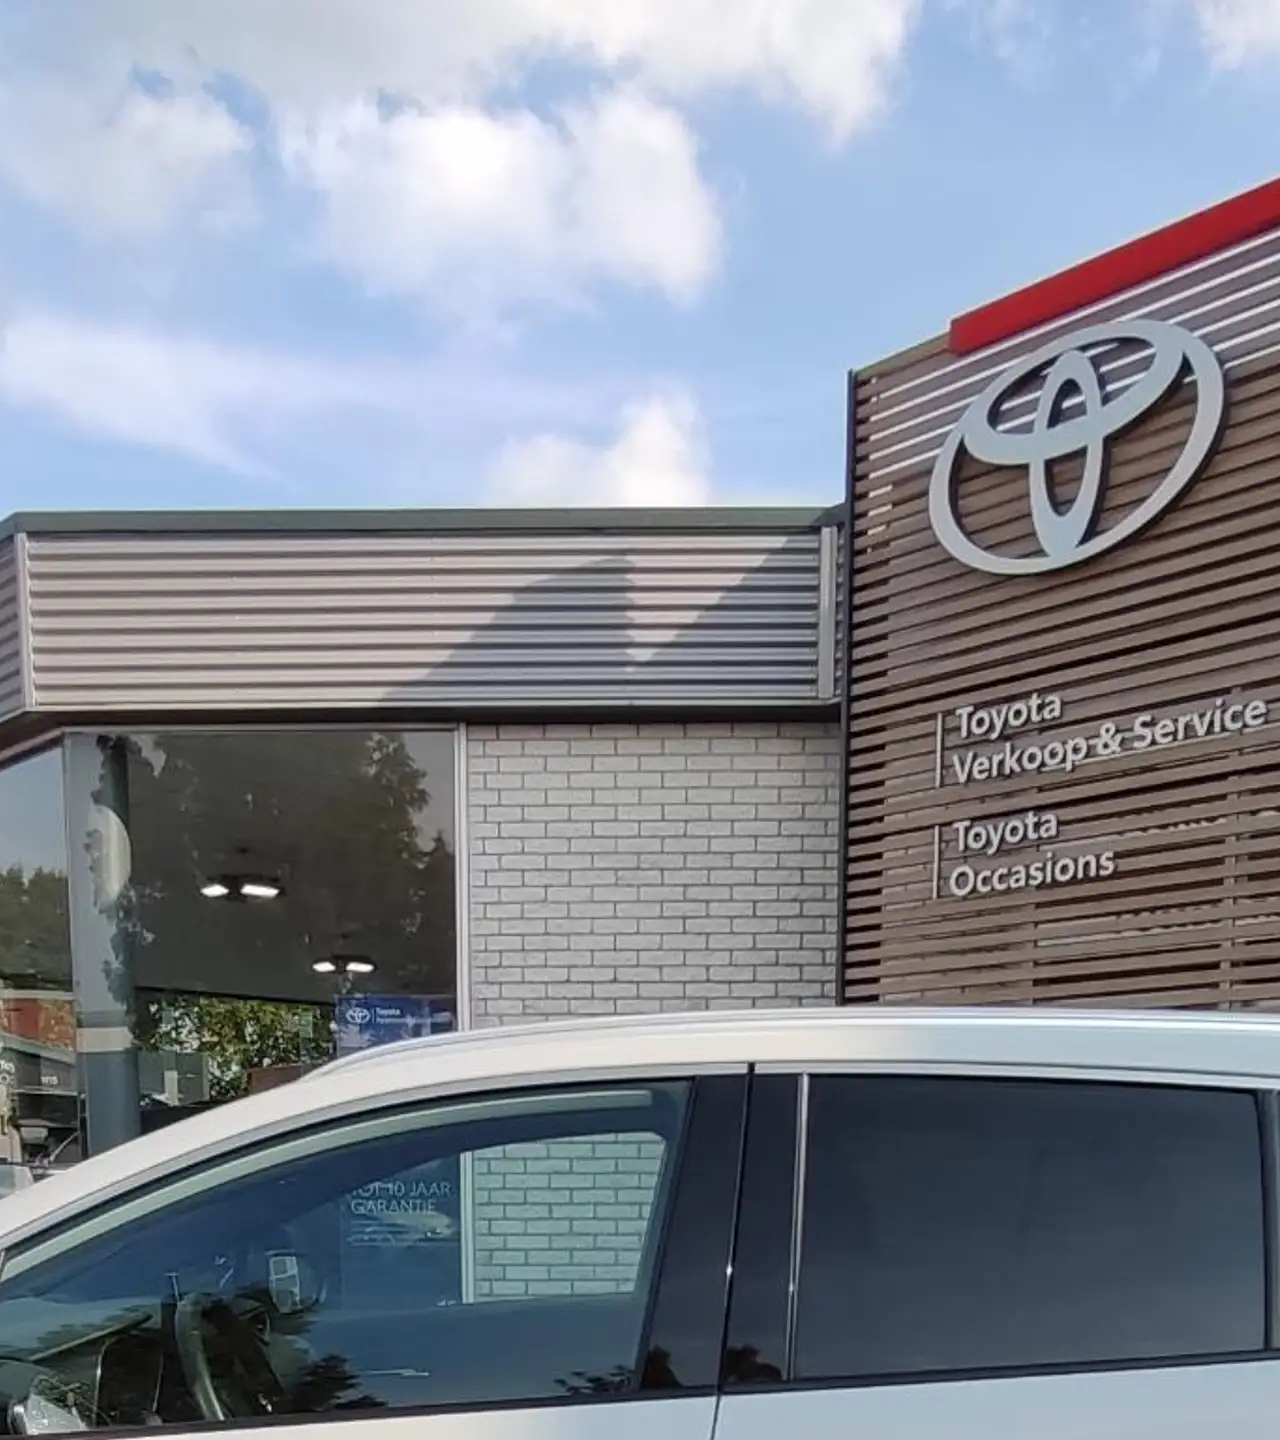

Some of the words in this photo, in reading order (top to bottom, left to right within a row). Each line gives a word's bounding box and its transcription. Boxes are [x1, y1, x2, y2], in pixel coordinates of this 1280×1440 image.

[955, 691, 1063, 741] Toyota
[952, 734, 1088, 784] Verkoop
[1096, 721, 1122, 756] &
[1132, 697, 1268, 749] Service
[953, 810, 1059, 856] Toyota
[949, 850, 1116, 897] Occasions
[351, 1199, 438, 1215] GARANTIE
[410, 1181, 452, 1198] JAAR
